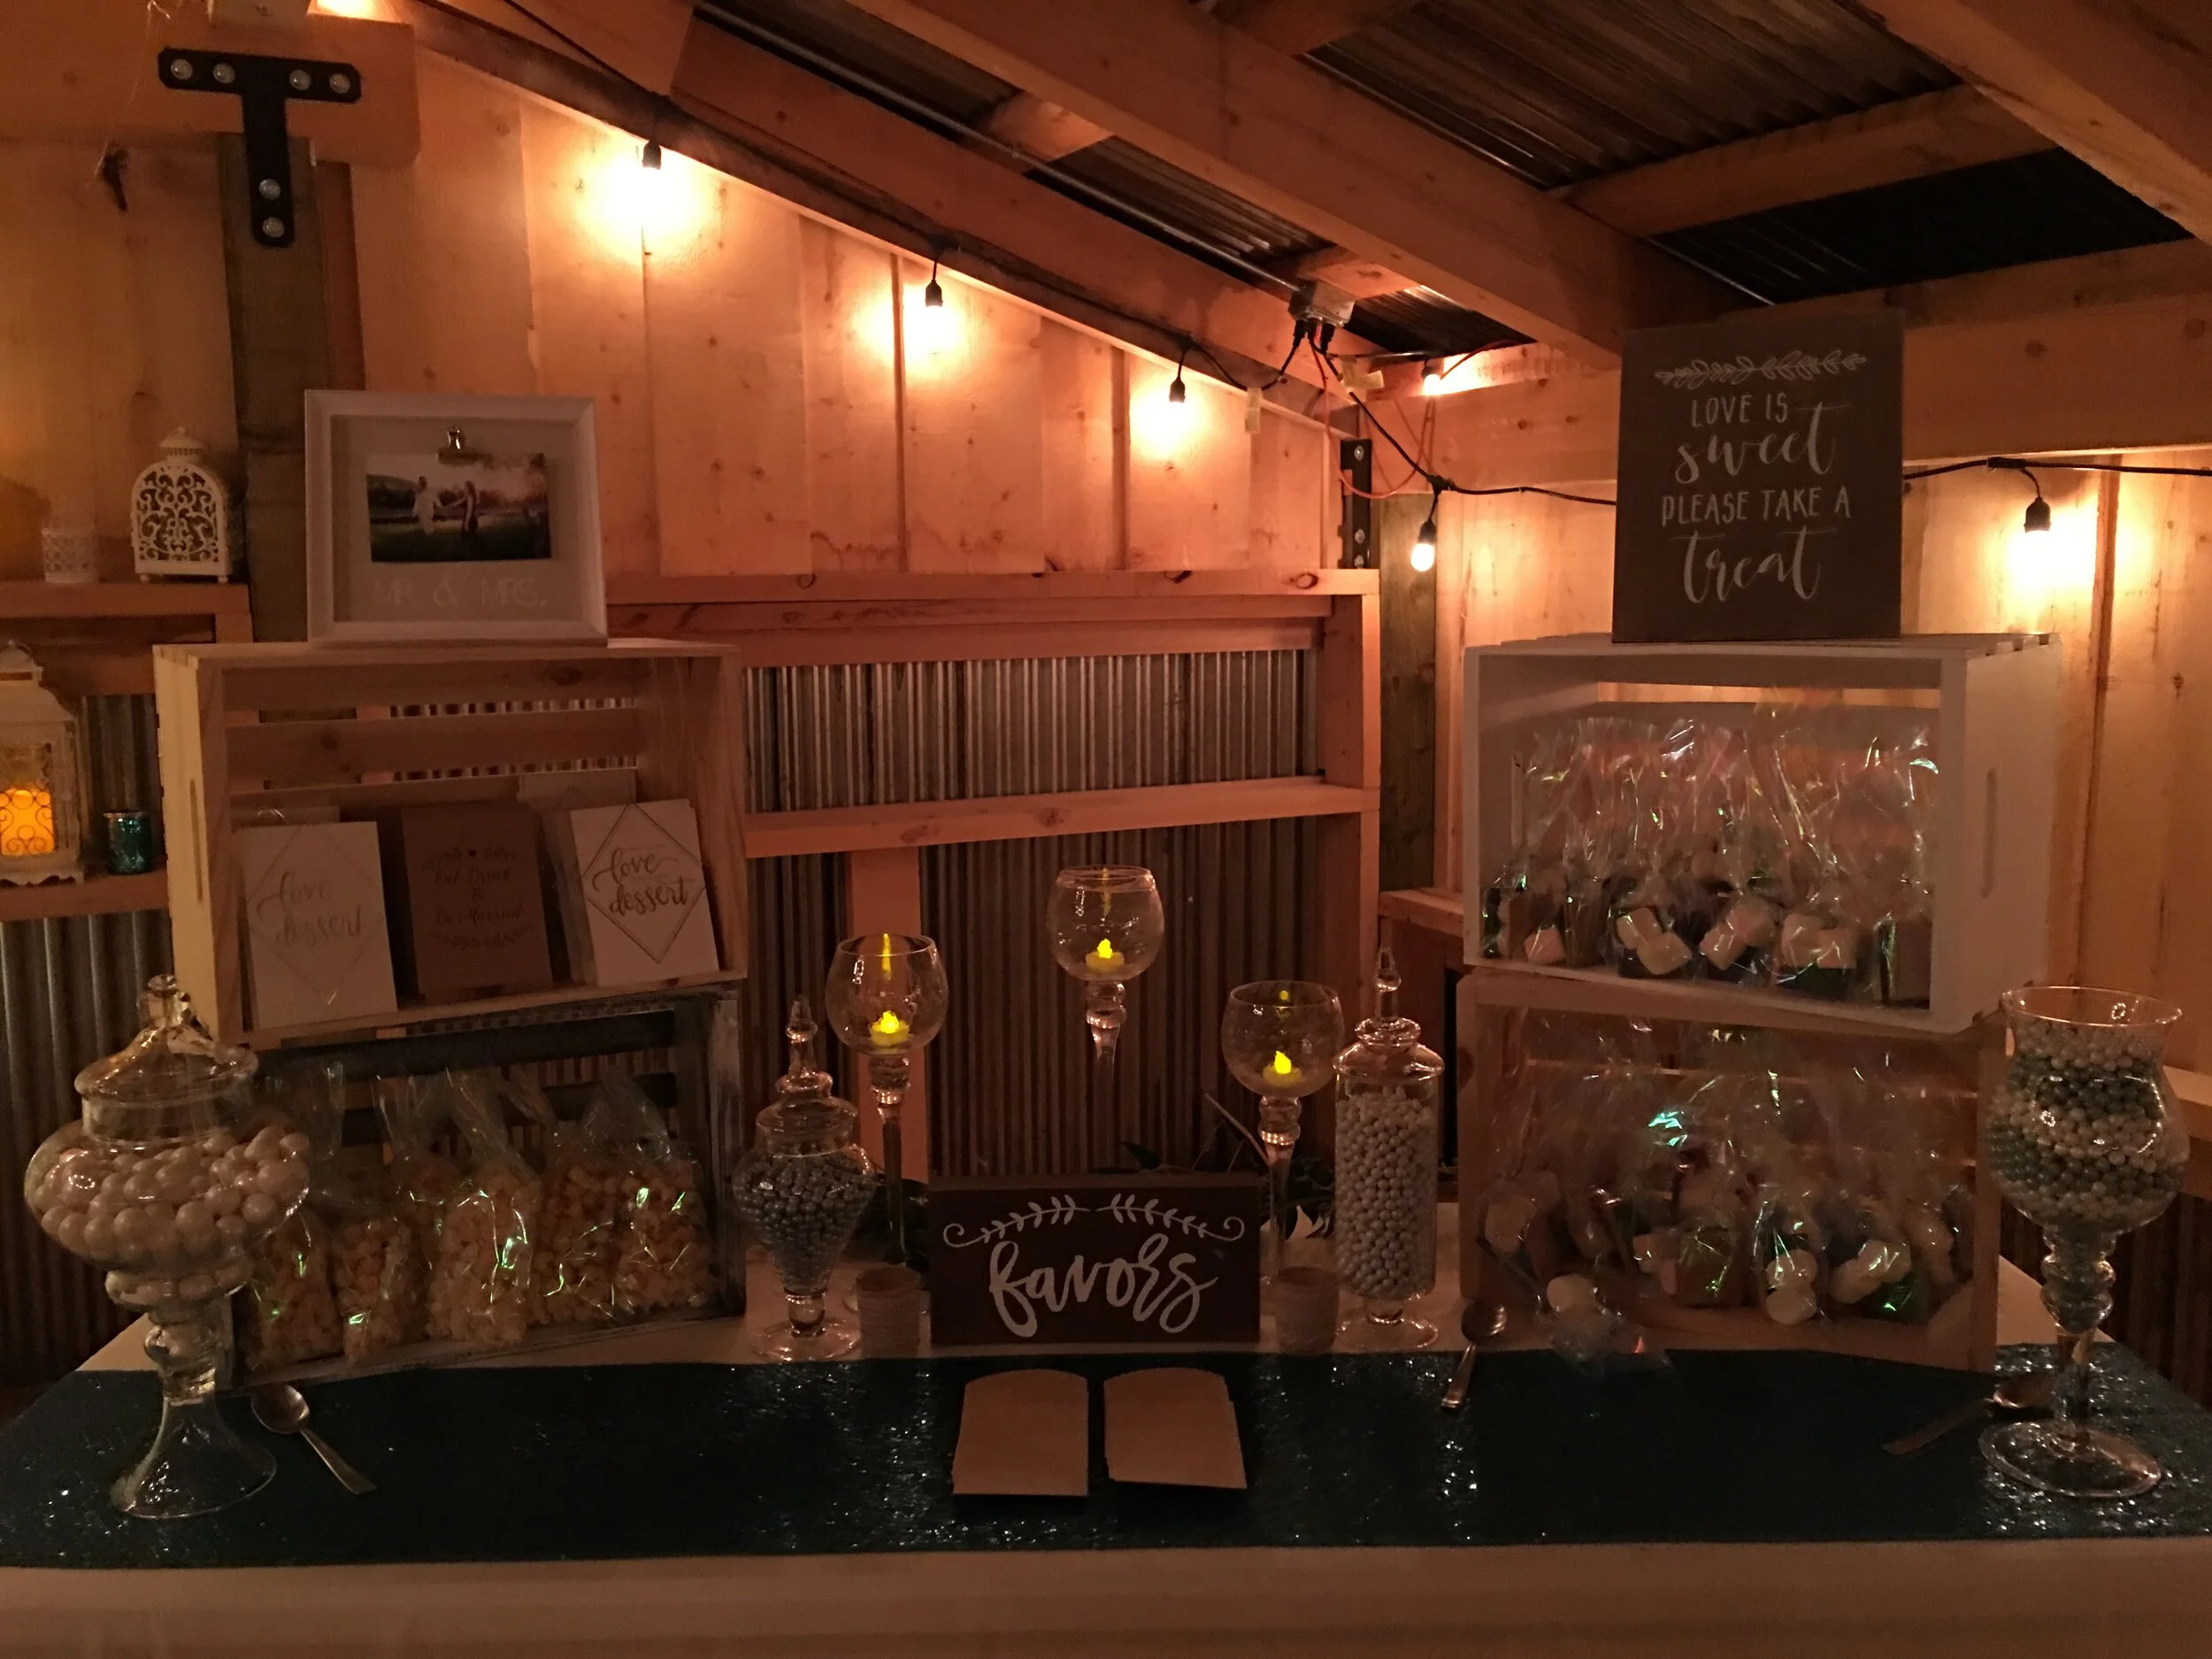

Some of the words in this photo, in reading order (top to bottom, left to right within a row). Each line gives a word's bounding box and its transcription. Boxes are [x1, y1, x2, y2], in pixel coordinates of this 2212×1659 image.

[1691, 393, 1753, 427] LOVE
[1765, 392, 1788, 424] IS
[1674, 401, 1852, 484] sweet
[1662, 491, 1750, 527] PLEASE
[1759, 487, 1823, 521] TAKE
[1833, 486, 1852, 518] A
[1669, 525, 1838, 603] treat
[592, 847, 680, 892] love
[609, 877, 695, 917] dessert
[988, 1233, 1219, 1338] favors
